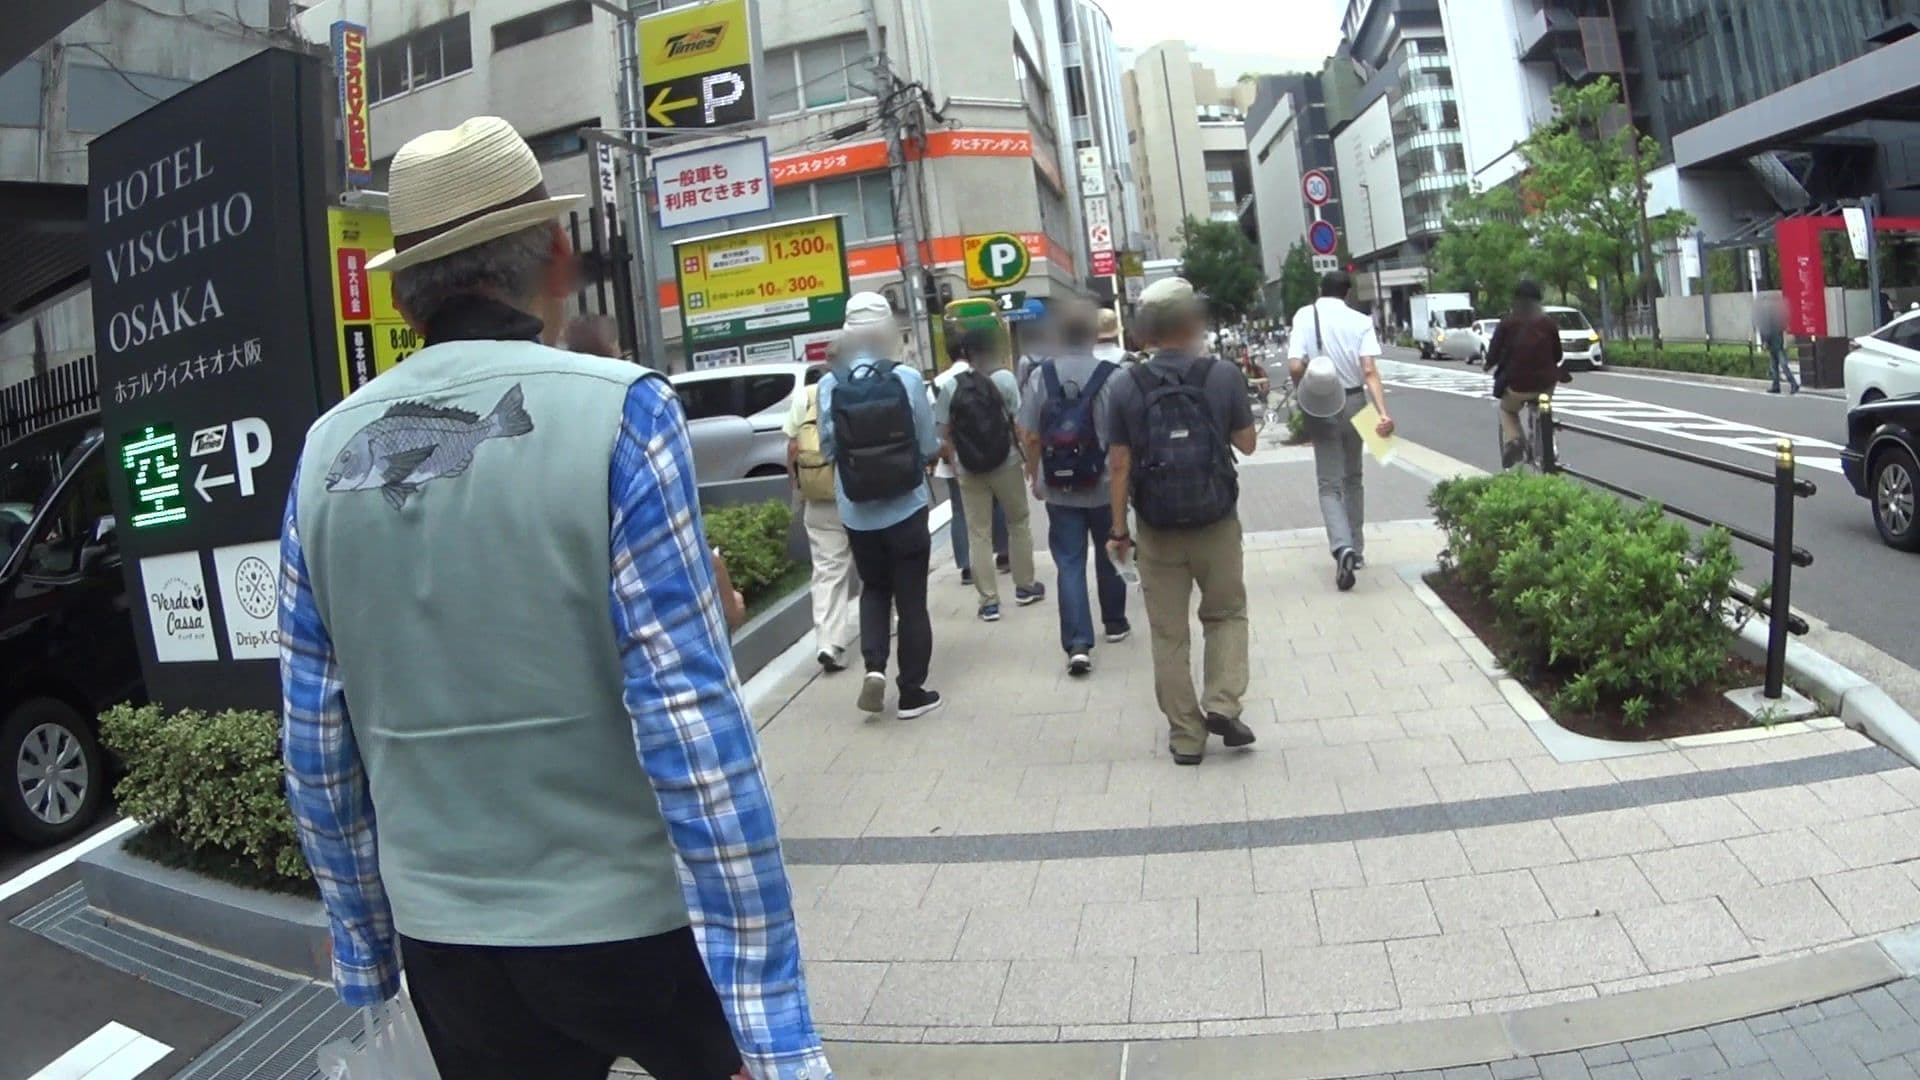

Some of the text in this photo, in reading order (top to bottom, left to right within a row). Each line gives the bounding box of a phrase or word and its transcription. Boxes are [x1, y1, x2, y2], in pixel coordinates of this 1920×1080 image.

[664, 24, 724, 58] Times
[702, 71, 744, 124] P
[103, 140, 214, 224] HOTEL
[663, 163, 729, 188] 一般車も
[664, 176, 764, 211] 利用できます
[1310, 180, 1325, 197] 30
[106, 191, 253, 284] VISCHIO
[989, 243, 1017, 278] P
[109, 280, 224, 353] OSAKA
[114, 337, 263, 404] ホテルヴィスキオ大阪
[122, 426, 187, 528] 空
[232, 416, 273, 497] P
[151, 589, 191, 612] Verde
[167, 611, 205, 636] Cassa
